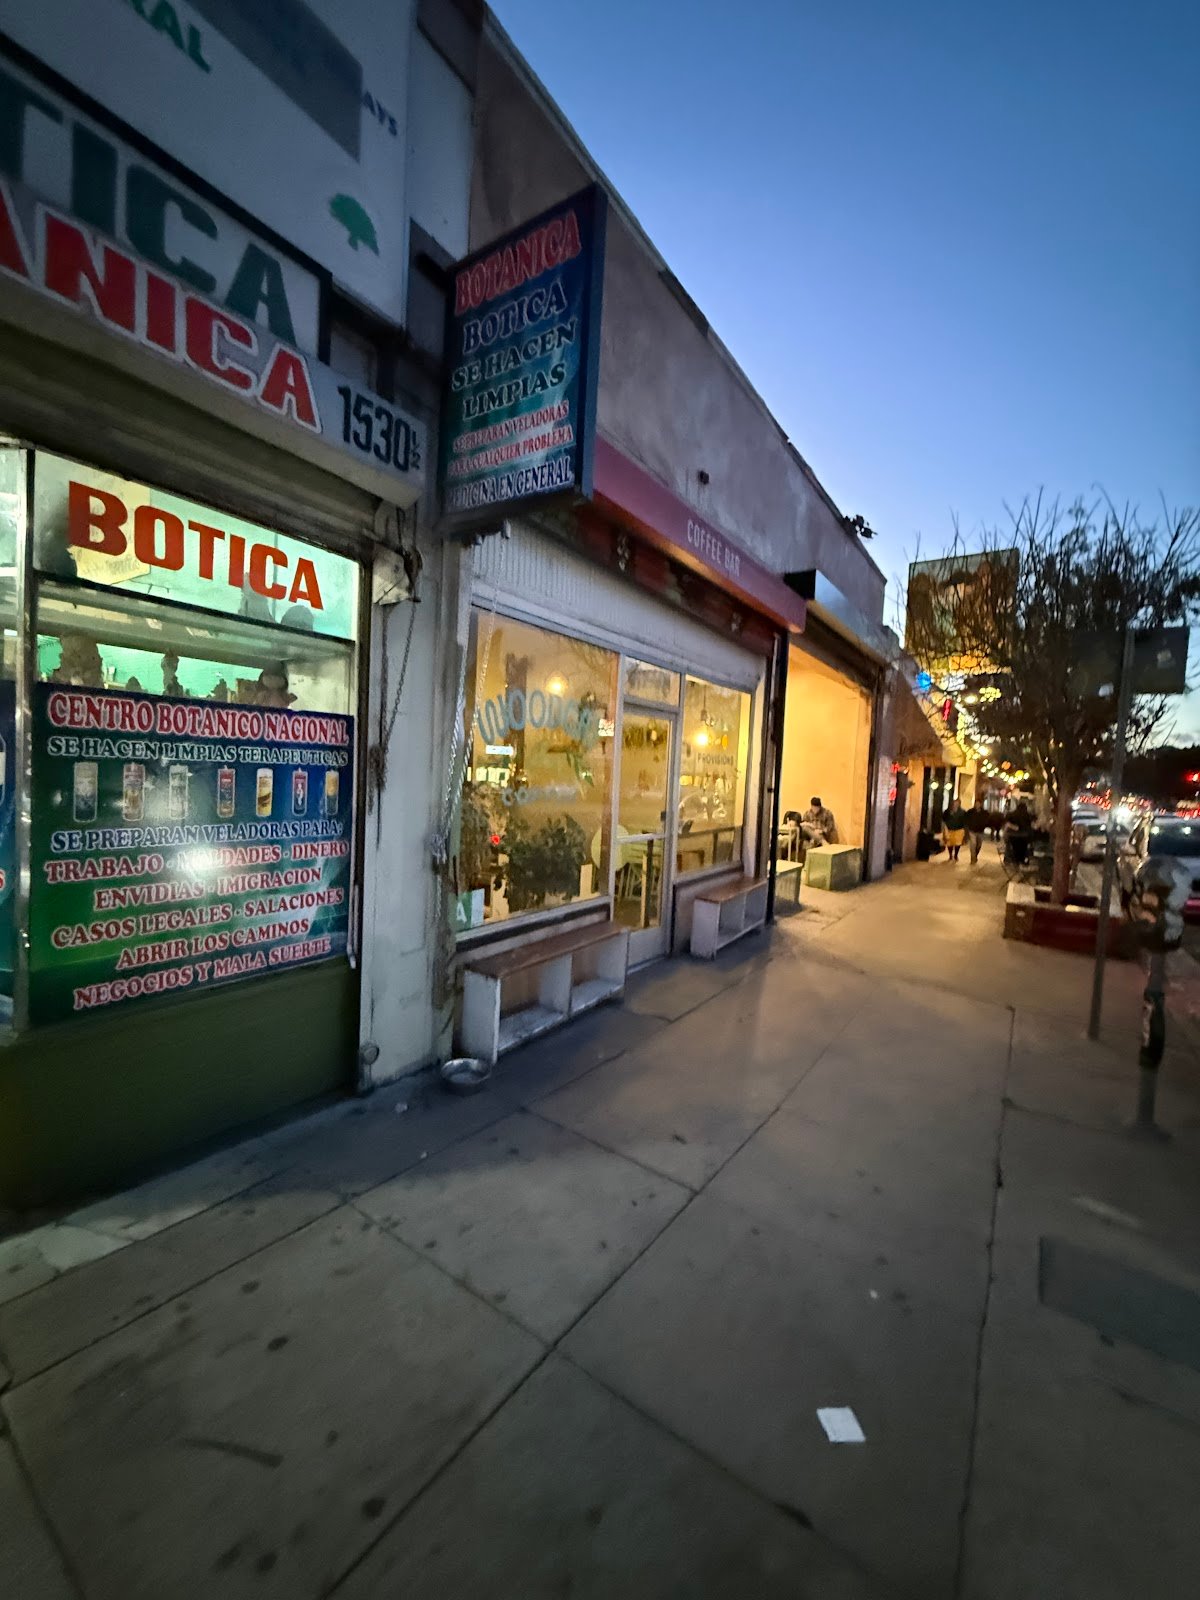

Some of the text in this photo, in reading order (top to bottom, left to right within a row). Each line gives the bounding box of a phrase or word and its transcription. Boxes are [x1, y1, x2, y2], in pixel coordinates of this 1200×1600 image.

[455, 209, 583, 317] BOTANICA
[462, 277, 568, 354] BOTICA
[451, 317, 578, 391] SE HACEN
[462, 362, 566, 421] LIMPIAS
[512, 399, 569, 432] VELADORAS
[471, 442, 521, 471] CUALQUIER
[522, 423, 573, 456] PROBLEMA
[498, 473, 516, 500] EN
[514, 455, 571, 496] GENERAL
[67, 480, 324, 611] BOTICA
[687, 519, 741, 577] COFFEE BAR
[48, 692, 349, 746] CENTRO BOTANICO NACIONAL
[47, 736, 348, 766] SE HACEN LIMPIAS TERAPEUTICAS
[44, 854, 165, 883] TRABAJO
[290, 840, 349, 860] DINERO
[51, 830, 82, 853] SE
[85, 825, 200, 851] PREPARAN
[201, 820, 300, 842] VELADORAS
[93, 867, 323, 911] ENVIDIAS IMIGRACION
[51, 887, 344, 949] CASOS LEGALES SALACIONES
[116, 918, 310, 970] ABRIR LOS CAMINOS
[73, 936, 332, 1011] NEGOCIOS Y MALA SUERTE
